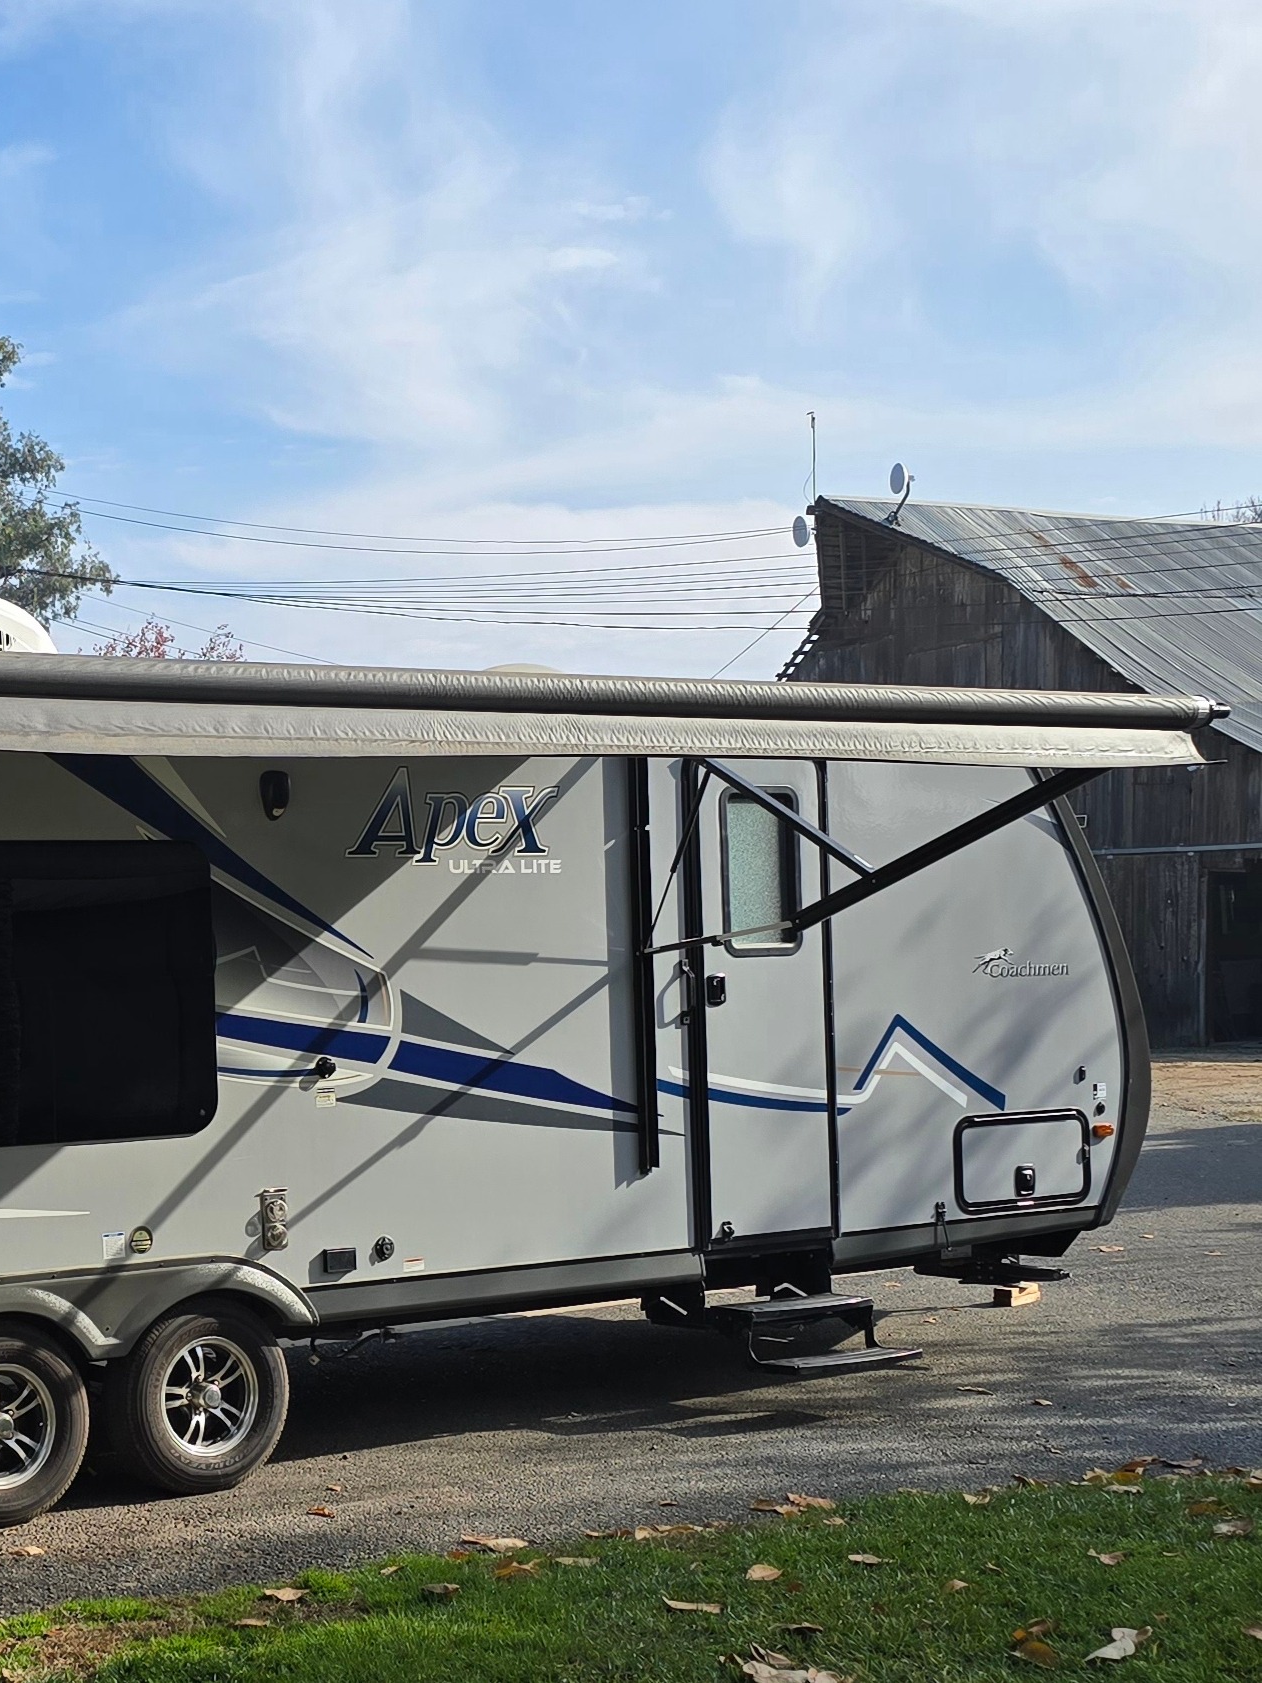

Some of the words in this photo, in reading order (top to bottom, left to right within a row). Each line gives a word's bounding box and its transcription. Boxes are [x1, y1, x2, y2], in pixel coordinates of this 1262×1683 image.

[449, 859, 515, 874] ULTRA
[520, 859, 562, 874] LITE
[988, 960, 1069, 978] Coachmen
